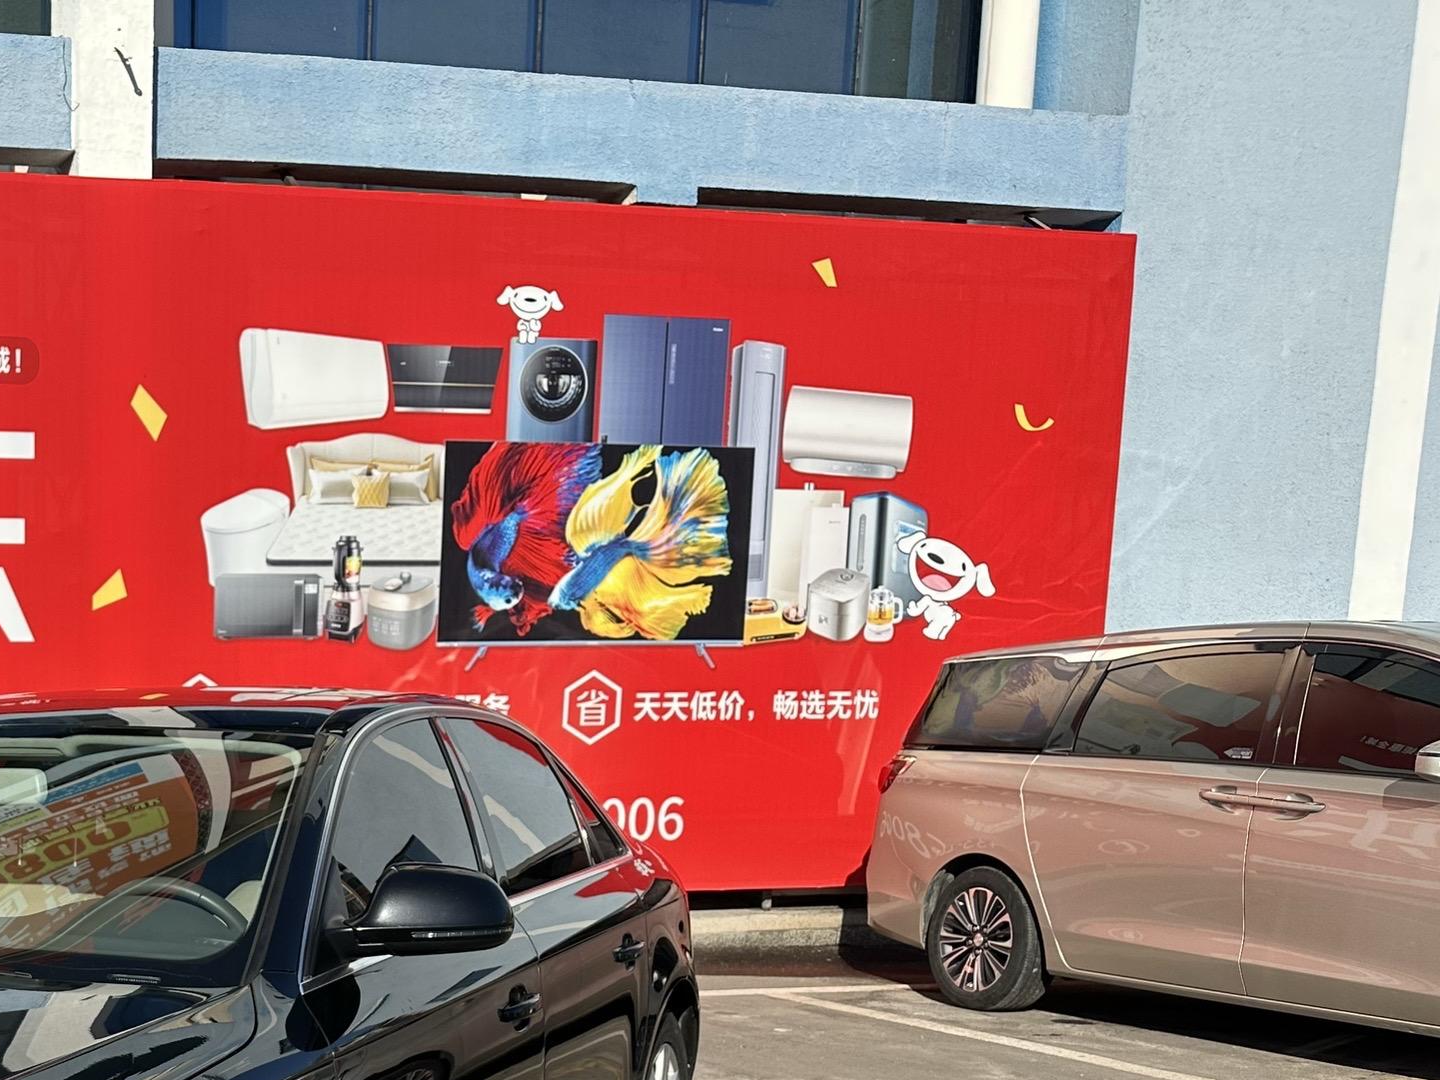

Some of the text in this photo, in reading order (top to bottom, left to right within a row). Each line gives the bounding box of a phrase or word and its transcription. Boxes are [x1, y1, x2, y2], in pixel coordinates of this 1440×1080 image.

[575, 689, 879, 728] 省 天天低价，畅选无忧
